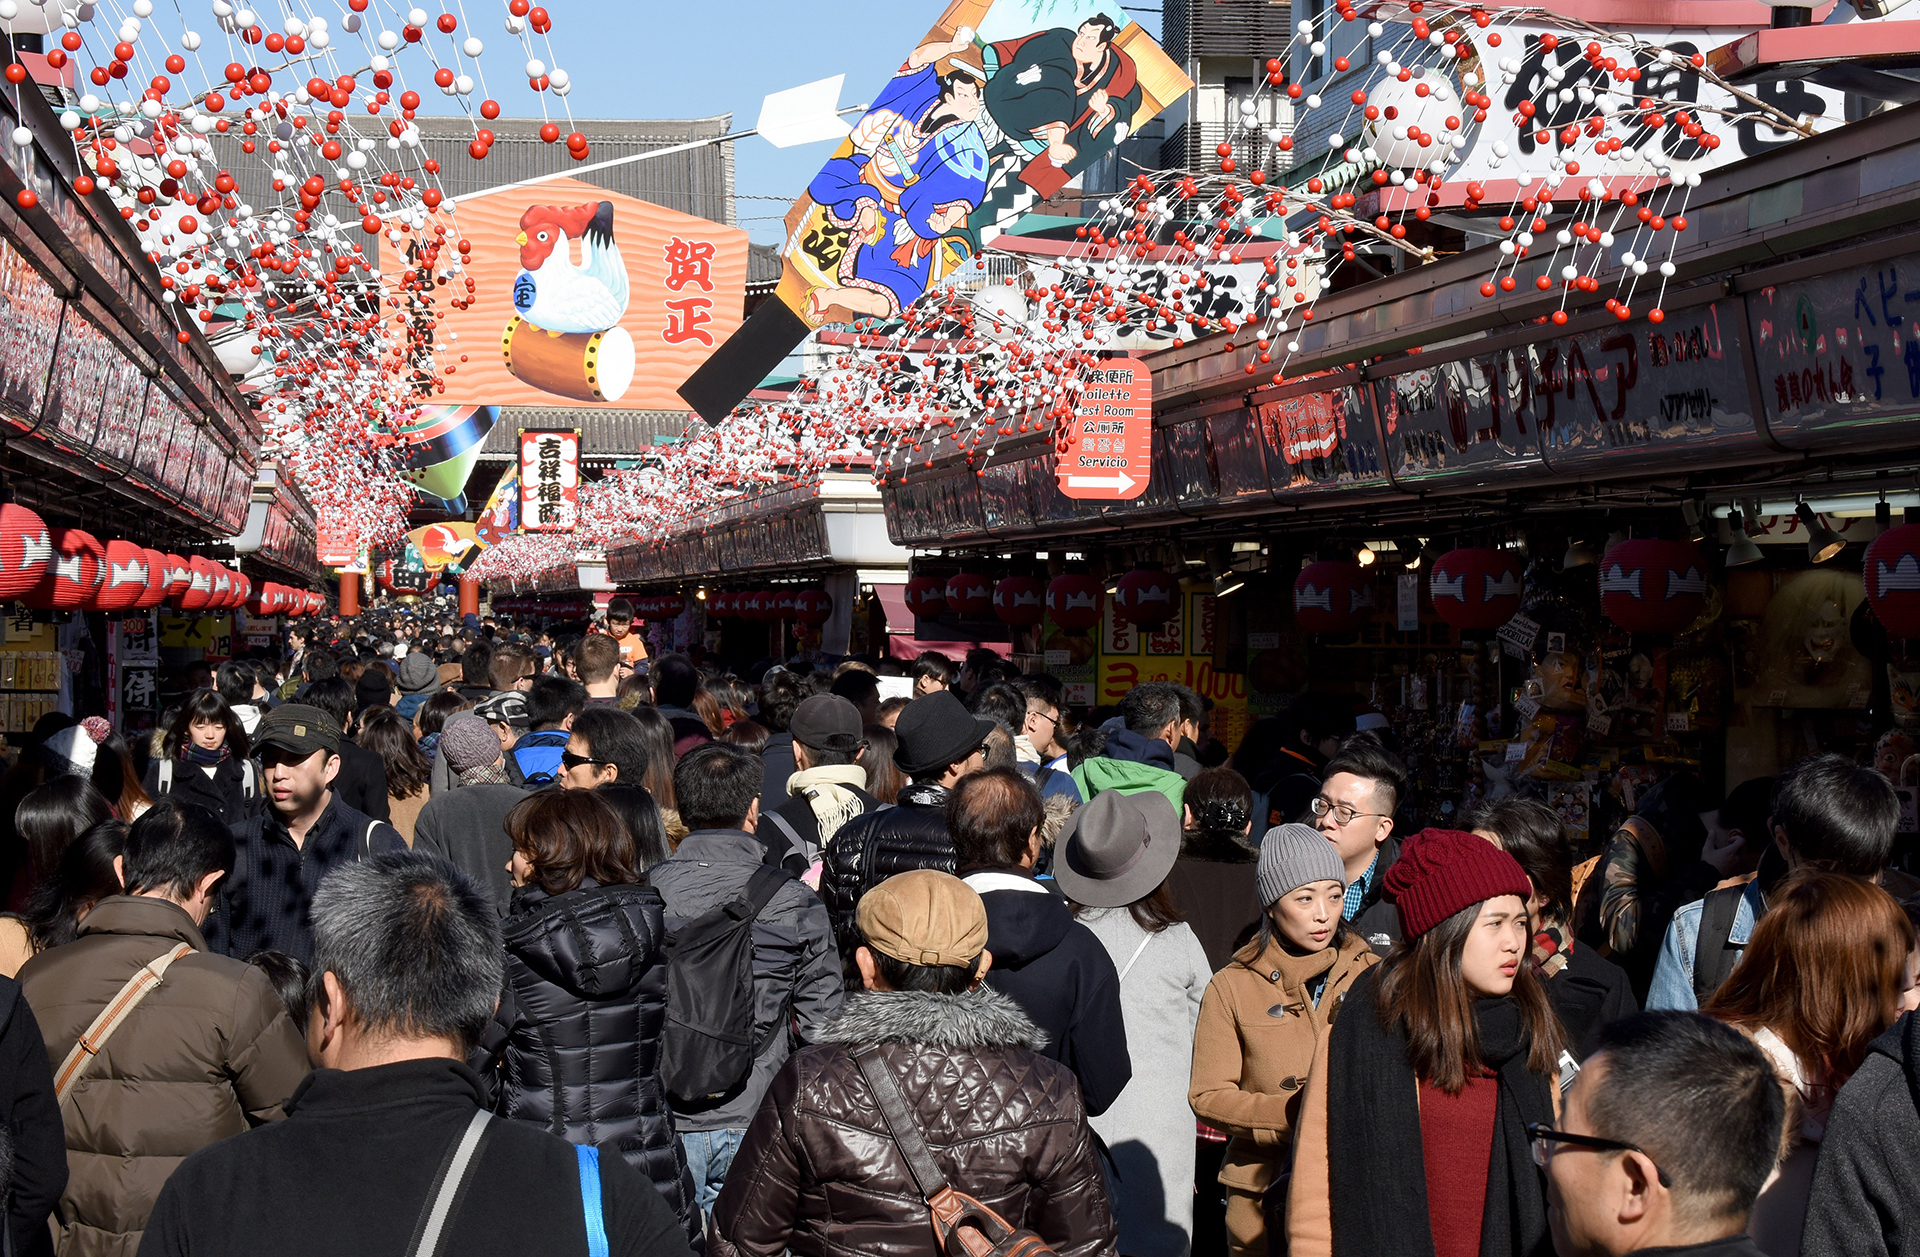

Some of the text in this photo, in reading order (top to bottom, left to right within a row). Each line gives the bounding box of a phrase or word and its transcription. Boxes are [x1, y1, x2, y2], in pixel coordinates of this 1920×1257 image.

[662, 235, 718, 348] 賀正
[1078, 369, 1134, 384] 衆便所
[1080, 404, 1134, 417] est Room
[1081, 437, 1125, 453] 화장실
[1078, 455, 1128, 468] Servicio
[1496, 624, 1532, 647] GODZILLA!
